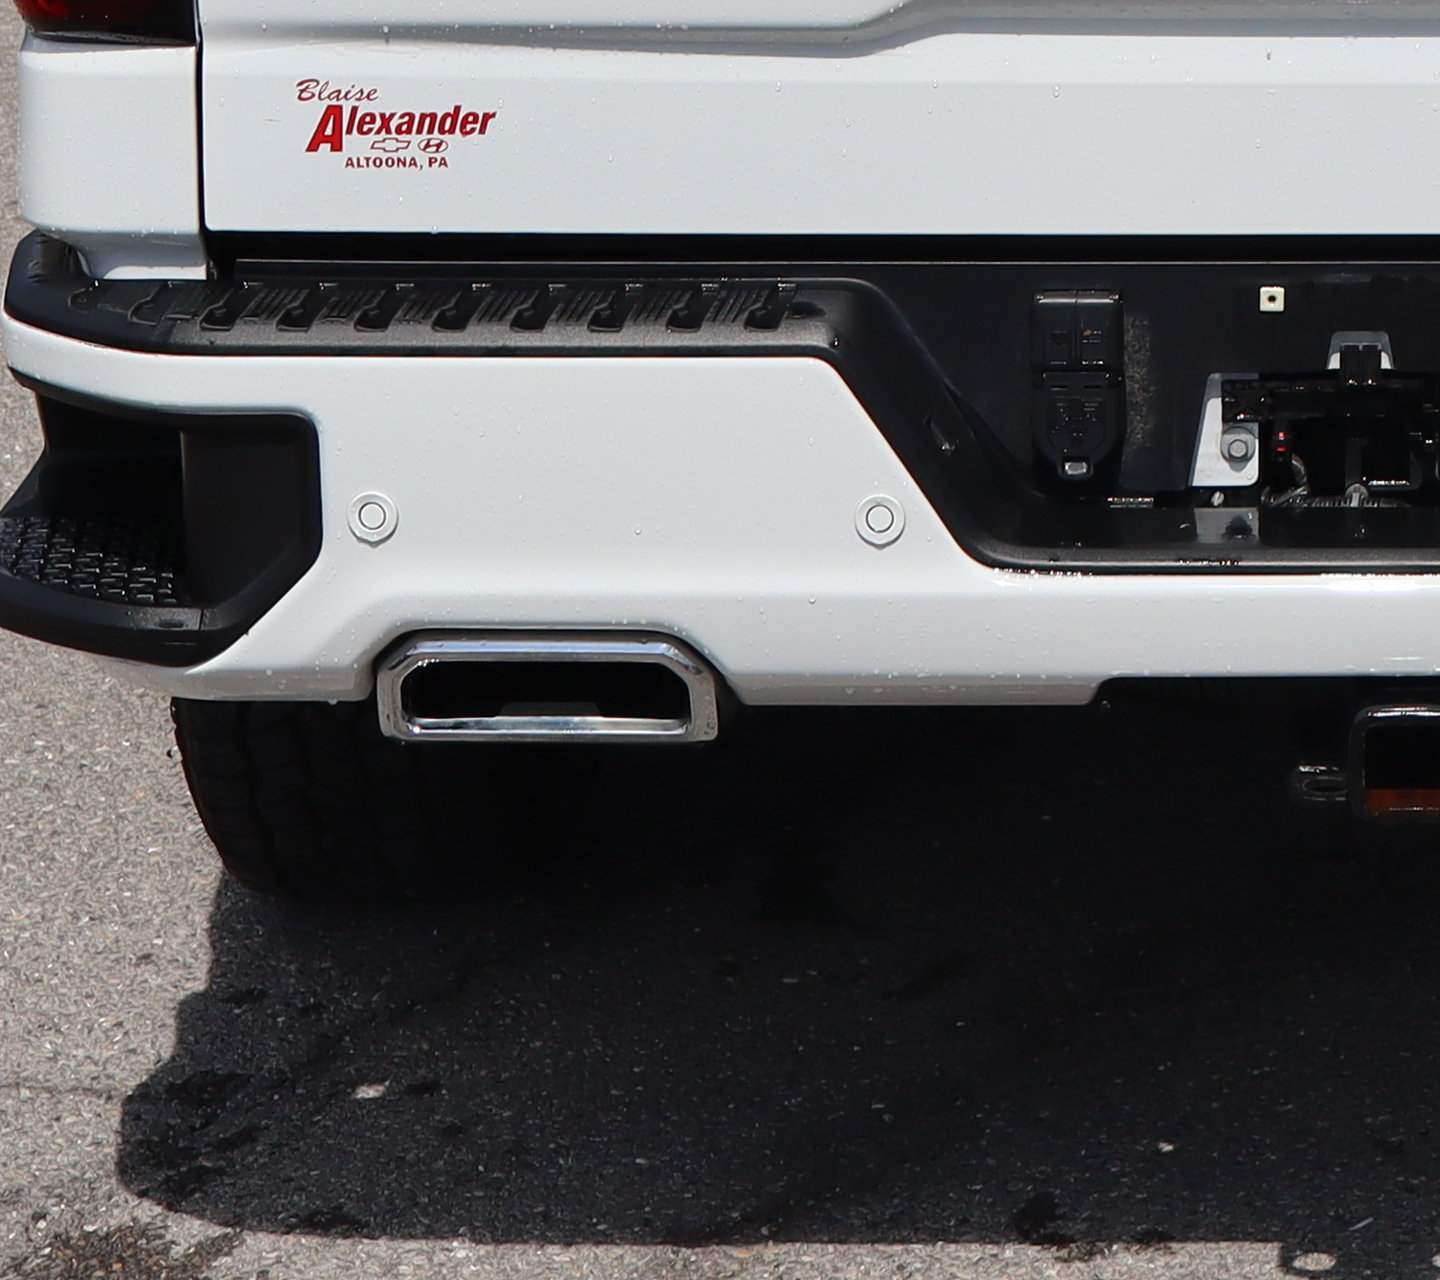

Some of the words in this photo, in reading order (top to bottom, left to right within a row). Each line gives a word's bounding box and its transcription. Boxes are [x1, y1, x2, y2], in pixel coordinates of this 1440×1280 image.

[295, 78, 379, 102] Blaise
[305, 104, 497, 153] Alexander
[345, 157, 424, 171] ALTOONA,
[428, 157, 449, 168] PA
